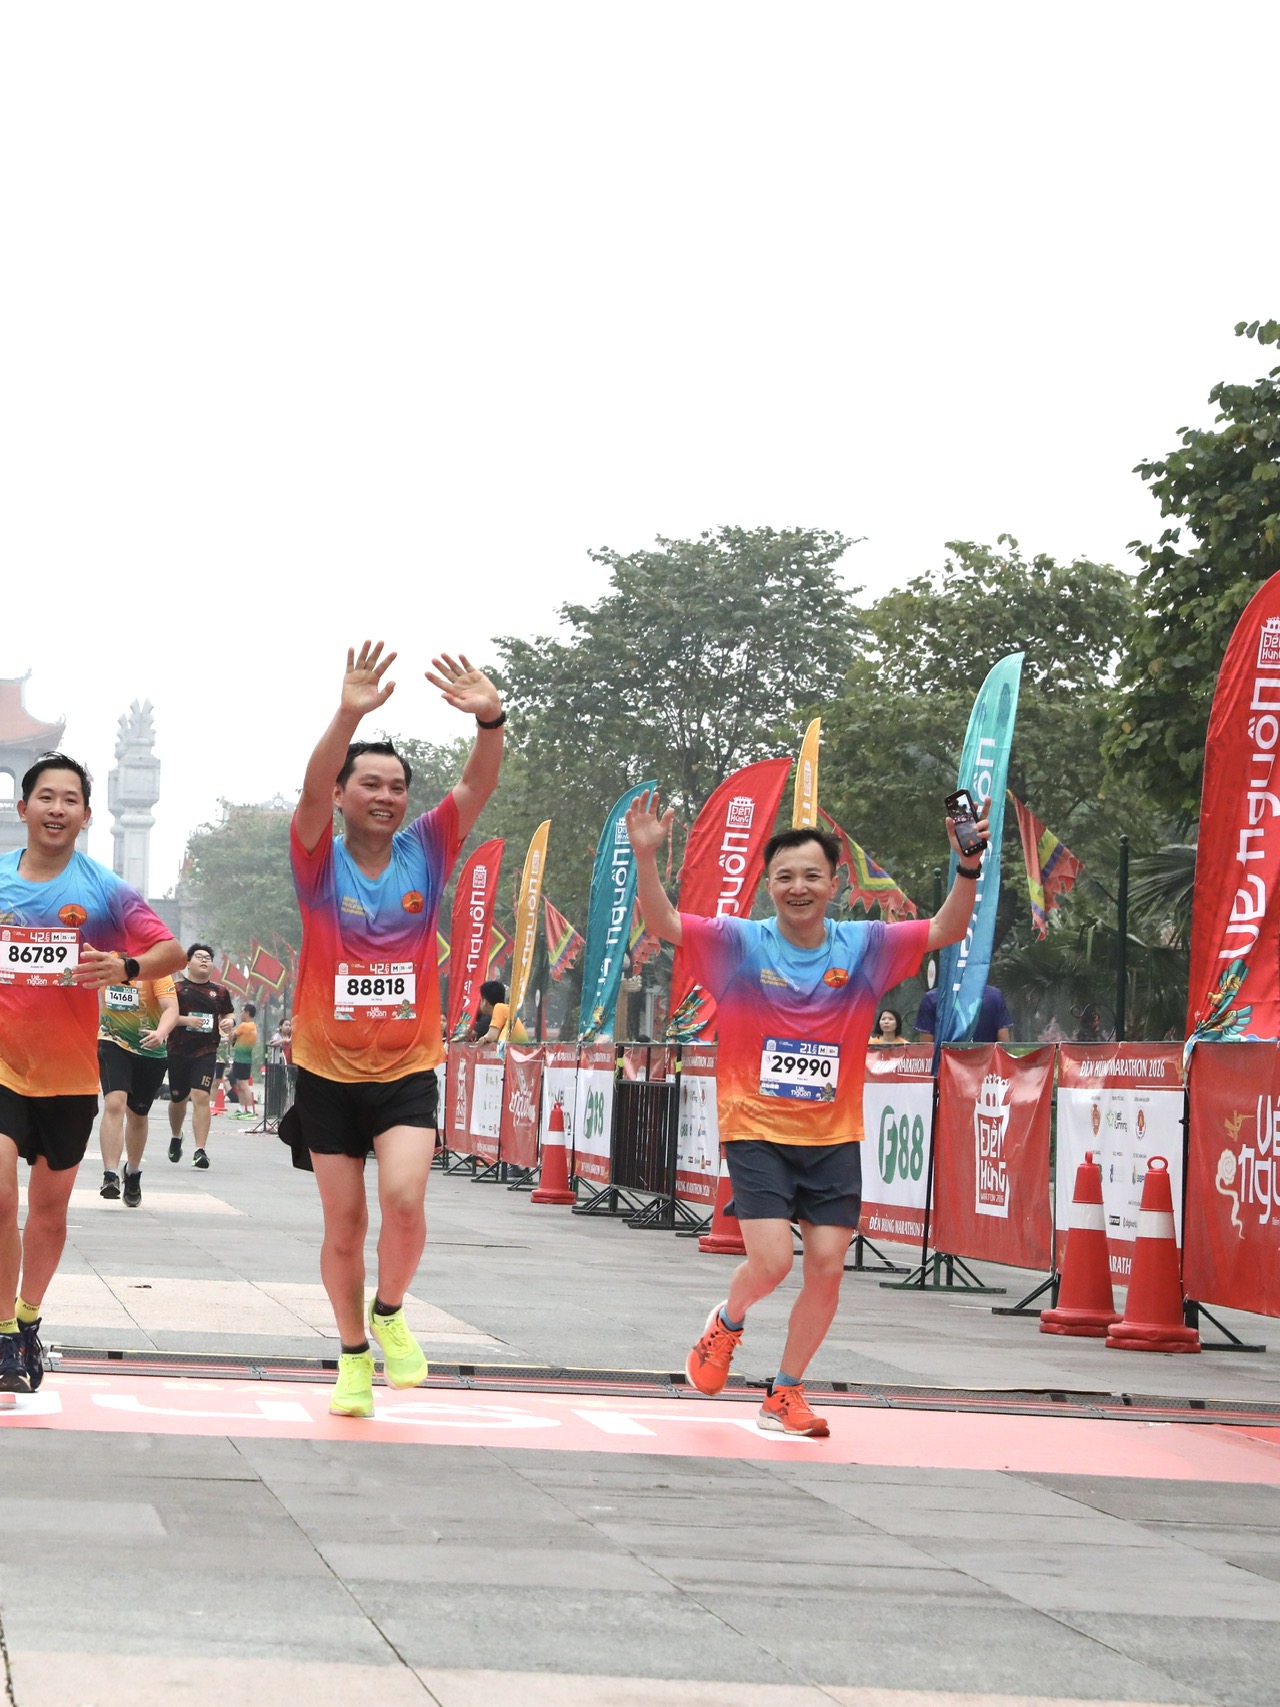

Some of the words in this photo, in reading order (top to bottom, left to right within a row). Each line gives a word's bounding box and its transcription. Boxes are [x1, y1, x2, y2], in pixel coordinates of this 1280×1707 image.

[717, 832, 750, 918] guồn
[30, 932, 44, 942] 42
[8, 945, 68, 963] 86789
[369, 963, 384, 974] 42
[347, 978, 405, 996] 88818
[110, 992, 133, 1002] 14168
[800, 1043, 812, 1055] 21
[771, 1055, 831, 1077] 29990
[1106, 1059, 1147, 1077] MARATHON
[1148, 1059, 1165, 1078] 2026
[201, 1075, 211, 1087] 15
[879, 1105, 924, 1185] F88
